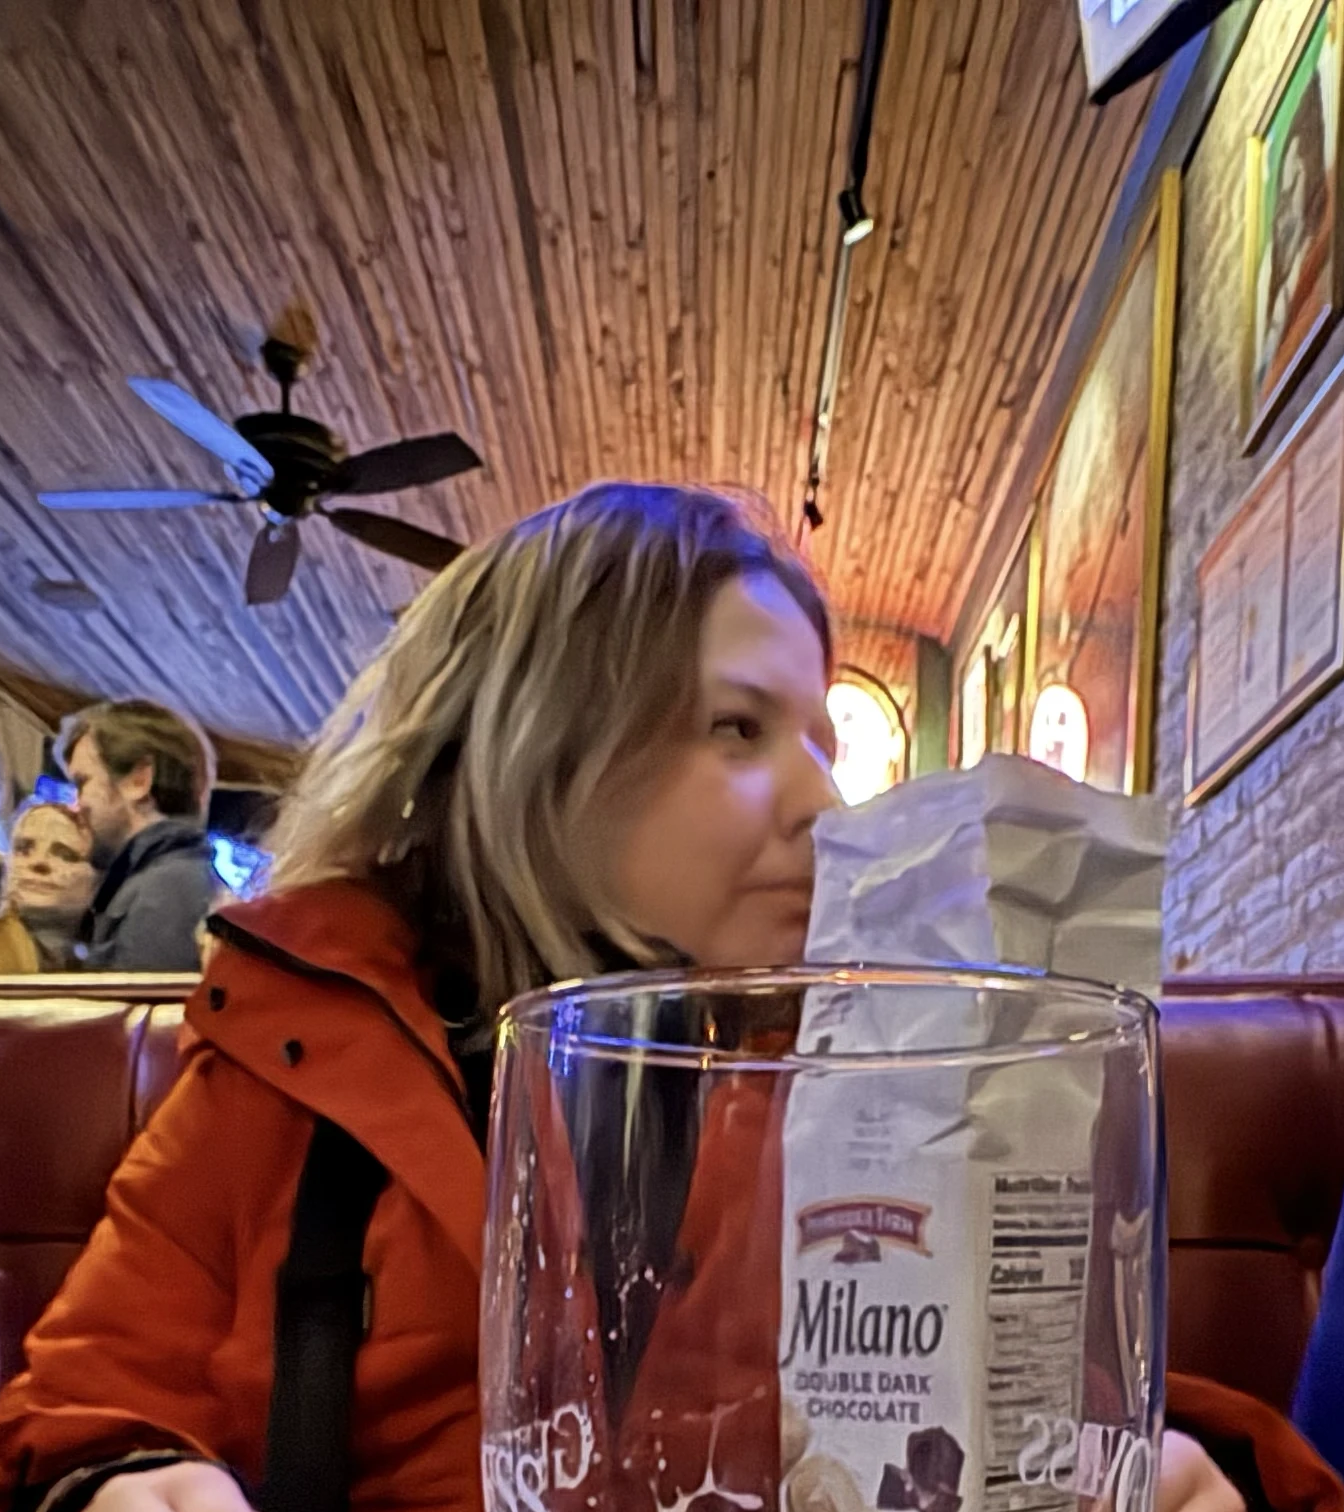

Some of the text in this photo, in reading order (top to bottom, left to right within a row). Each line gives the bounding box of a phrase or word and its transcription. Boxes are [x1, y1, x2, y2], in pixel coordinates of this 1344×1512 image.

[780, 1279, 944, 1367] Milano
[795, 1371, 933, 1395] DOUBLE DARK
[807, 1399, 921, 1424] CHOCOLATE
